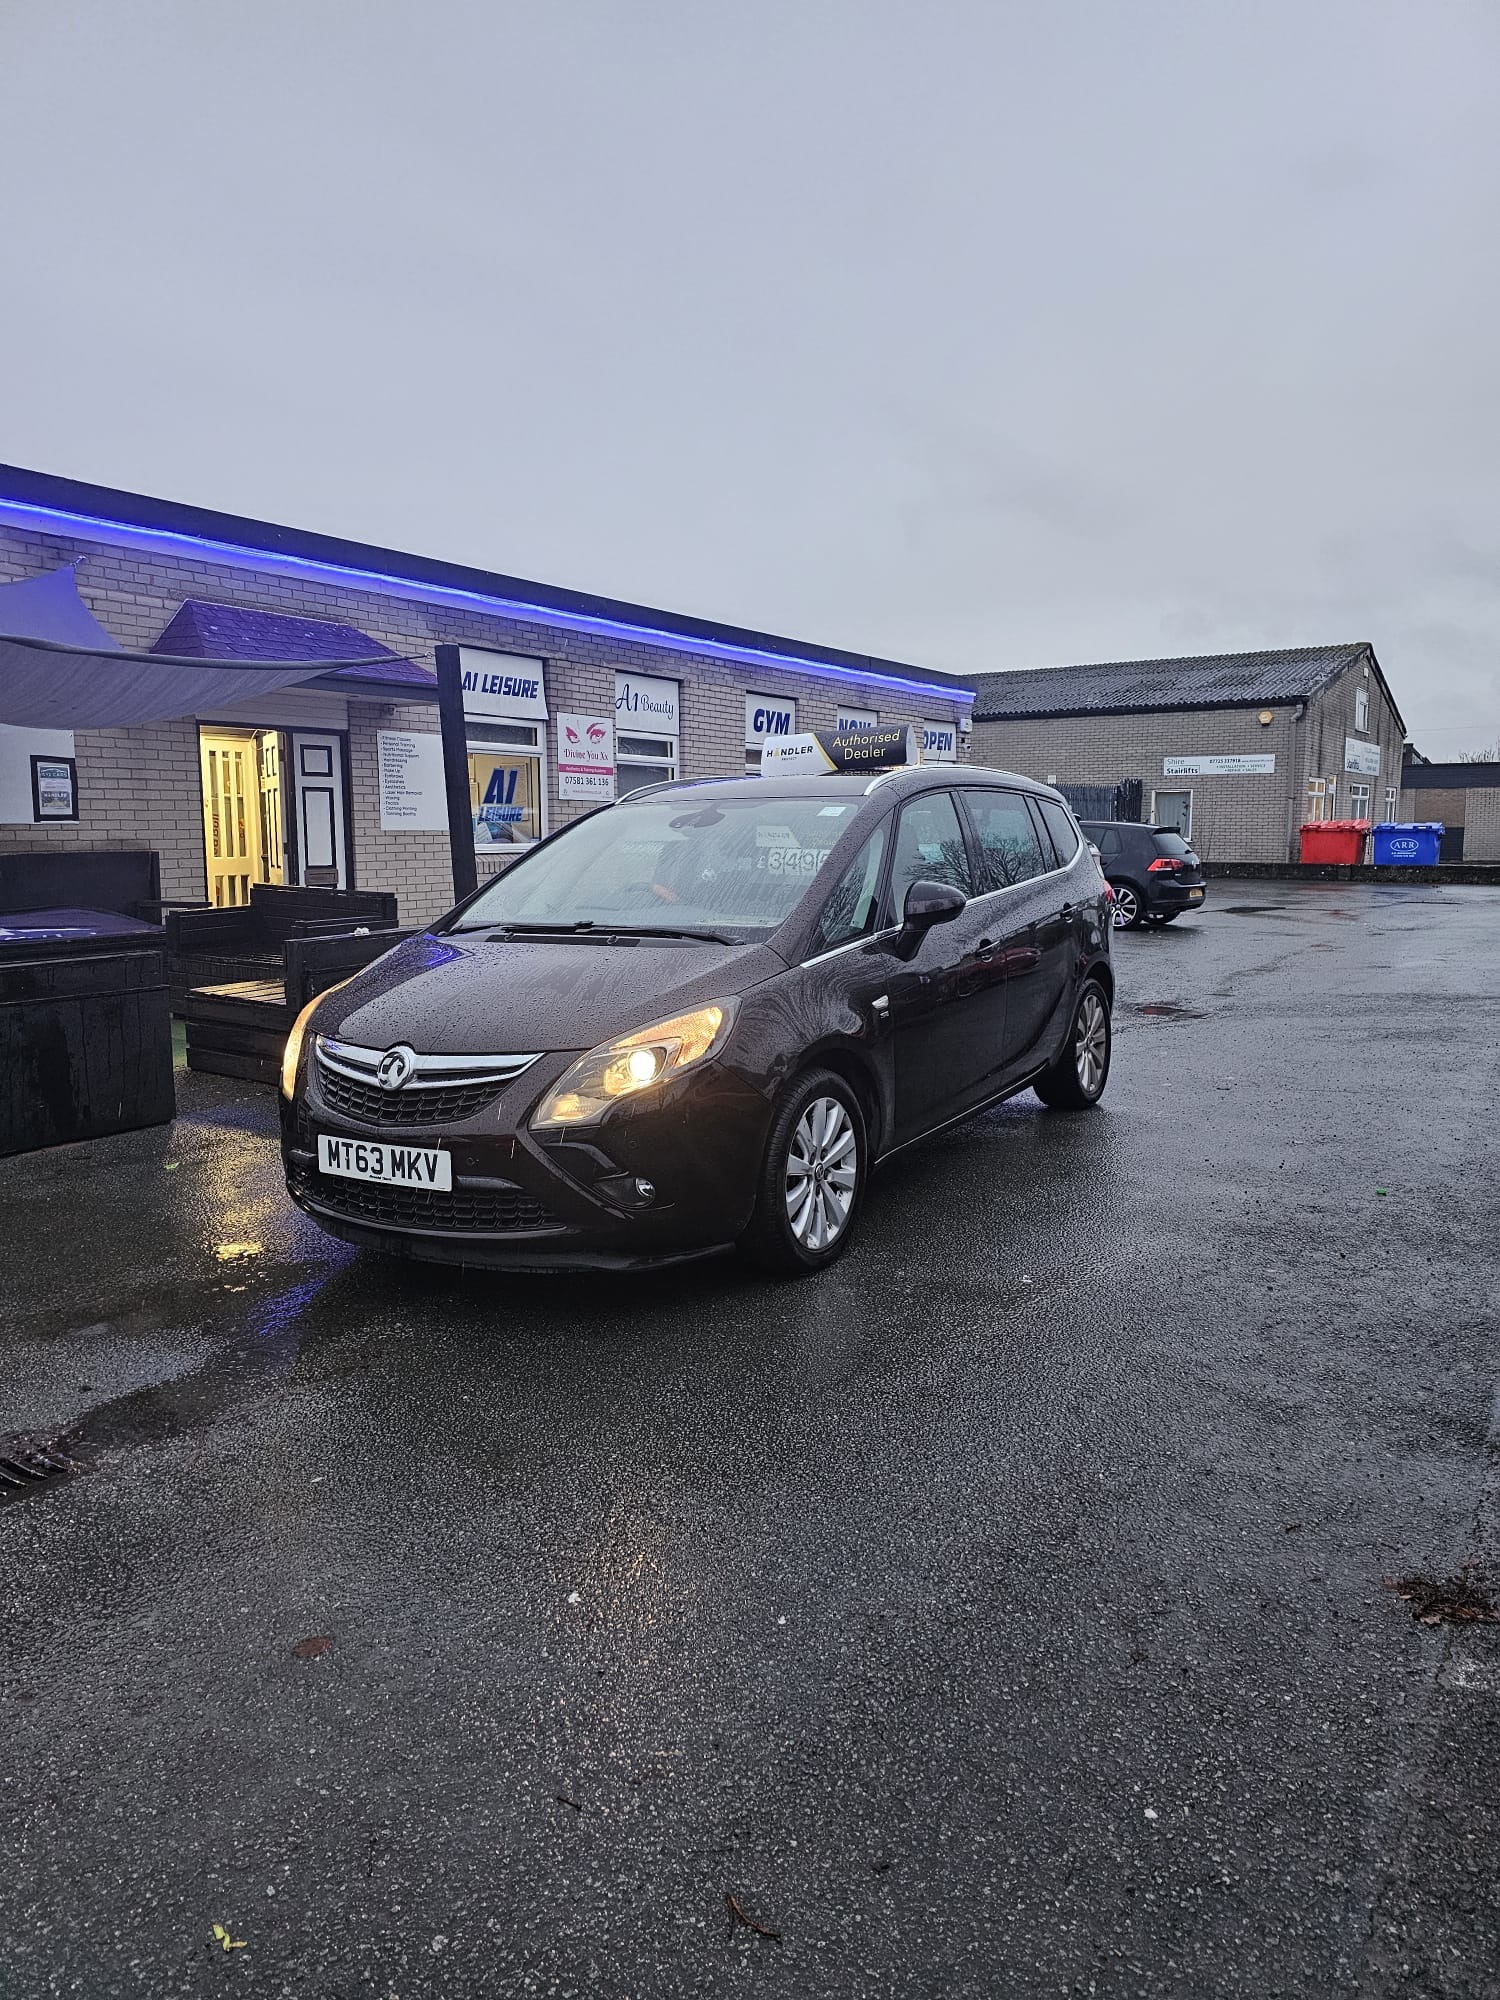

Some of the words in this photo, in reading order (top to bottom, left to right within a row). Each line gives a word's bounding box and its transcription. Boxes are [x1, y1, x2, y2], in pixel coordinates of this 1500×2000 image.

[481, 673, 539, 699] LEISURE
[615, 683, 639, 712] A1
[640, 694, 674, 720] Beauty
[753, 708, 791, 735] GYM
[832, 729, 901, 748] Authorised
[564, 748, 586, 760] Divine
[586, 750, 599, 762] You
[844, 746, 886, 760] Dealer
[1166, 766, 1199, 774] Stairlifts
[1167, 758, 1185, 766] Shire
[565, 776, 584, 785] 07581
[478, 806, 523, 822] LEISURE
[1394, 841, 1416, 849] ARR
[756, 851, 829, 871] £349
[327, 1139, 384, 1175] MT63
[390, 1148, 438, 1183] MKV
